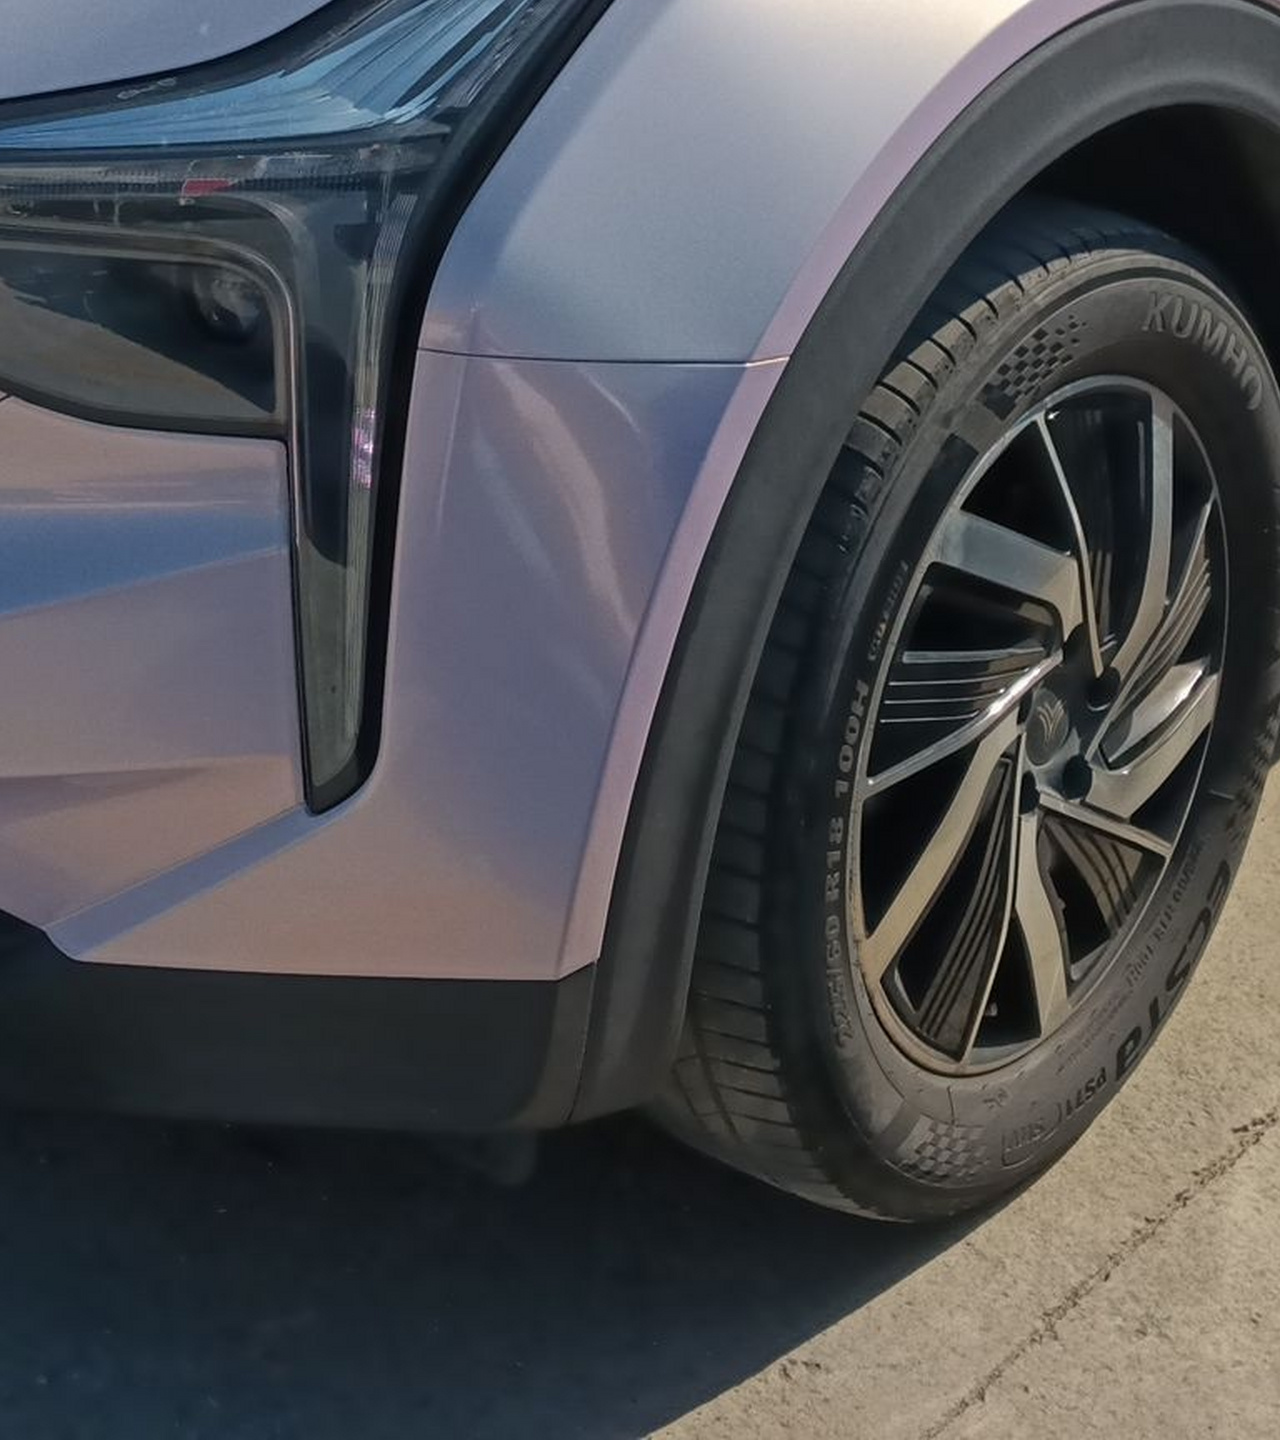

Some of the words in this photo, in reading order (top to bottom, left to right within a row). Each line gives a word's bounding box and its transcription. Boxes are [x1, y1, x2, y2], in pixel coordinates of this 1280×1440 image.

[1140, 290, 1263, 411] KUMHO
[833, 678, 870, 800] 100H
[825, 815, 844, 898] R18
[1064, 1067, 1108, 1119] PS71
